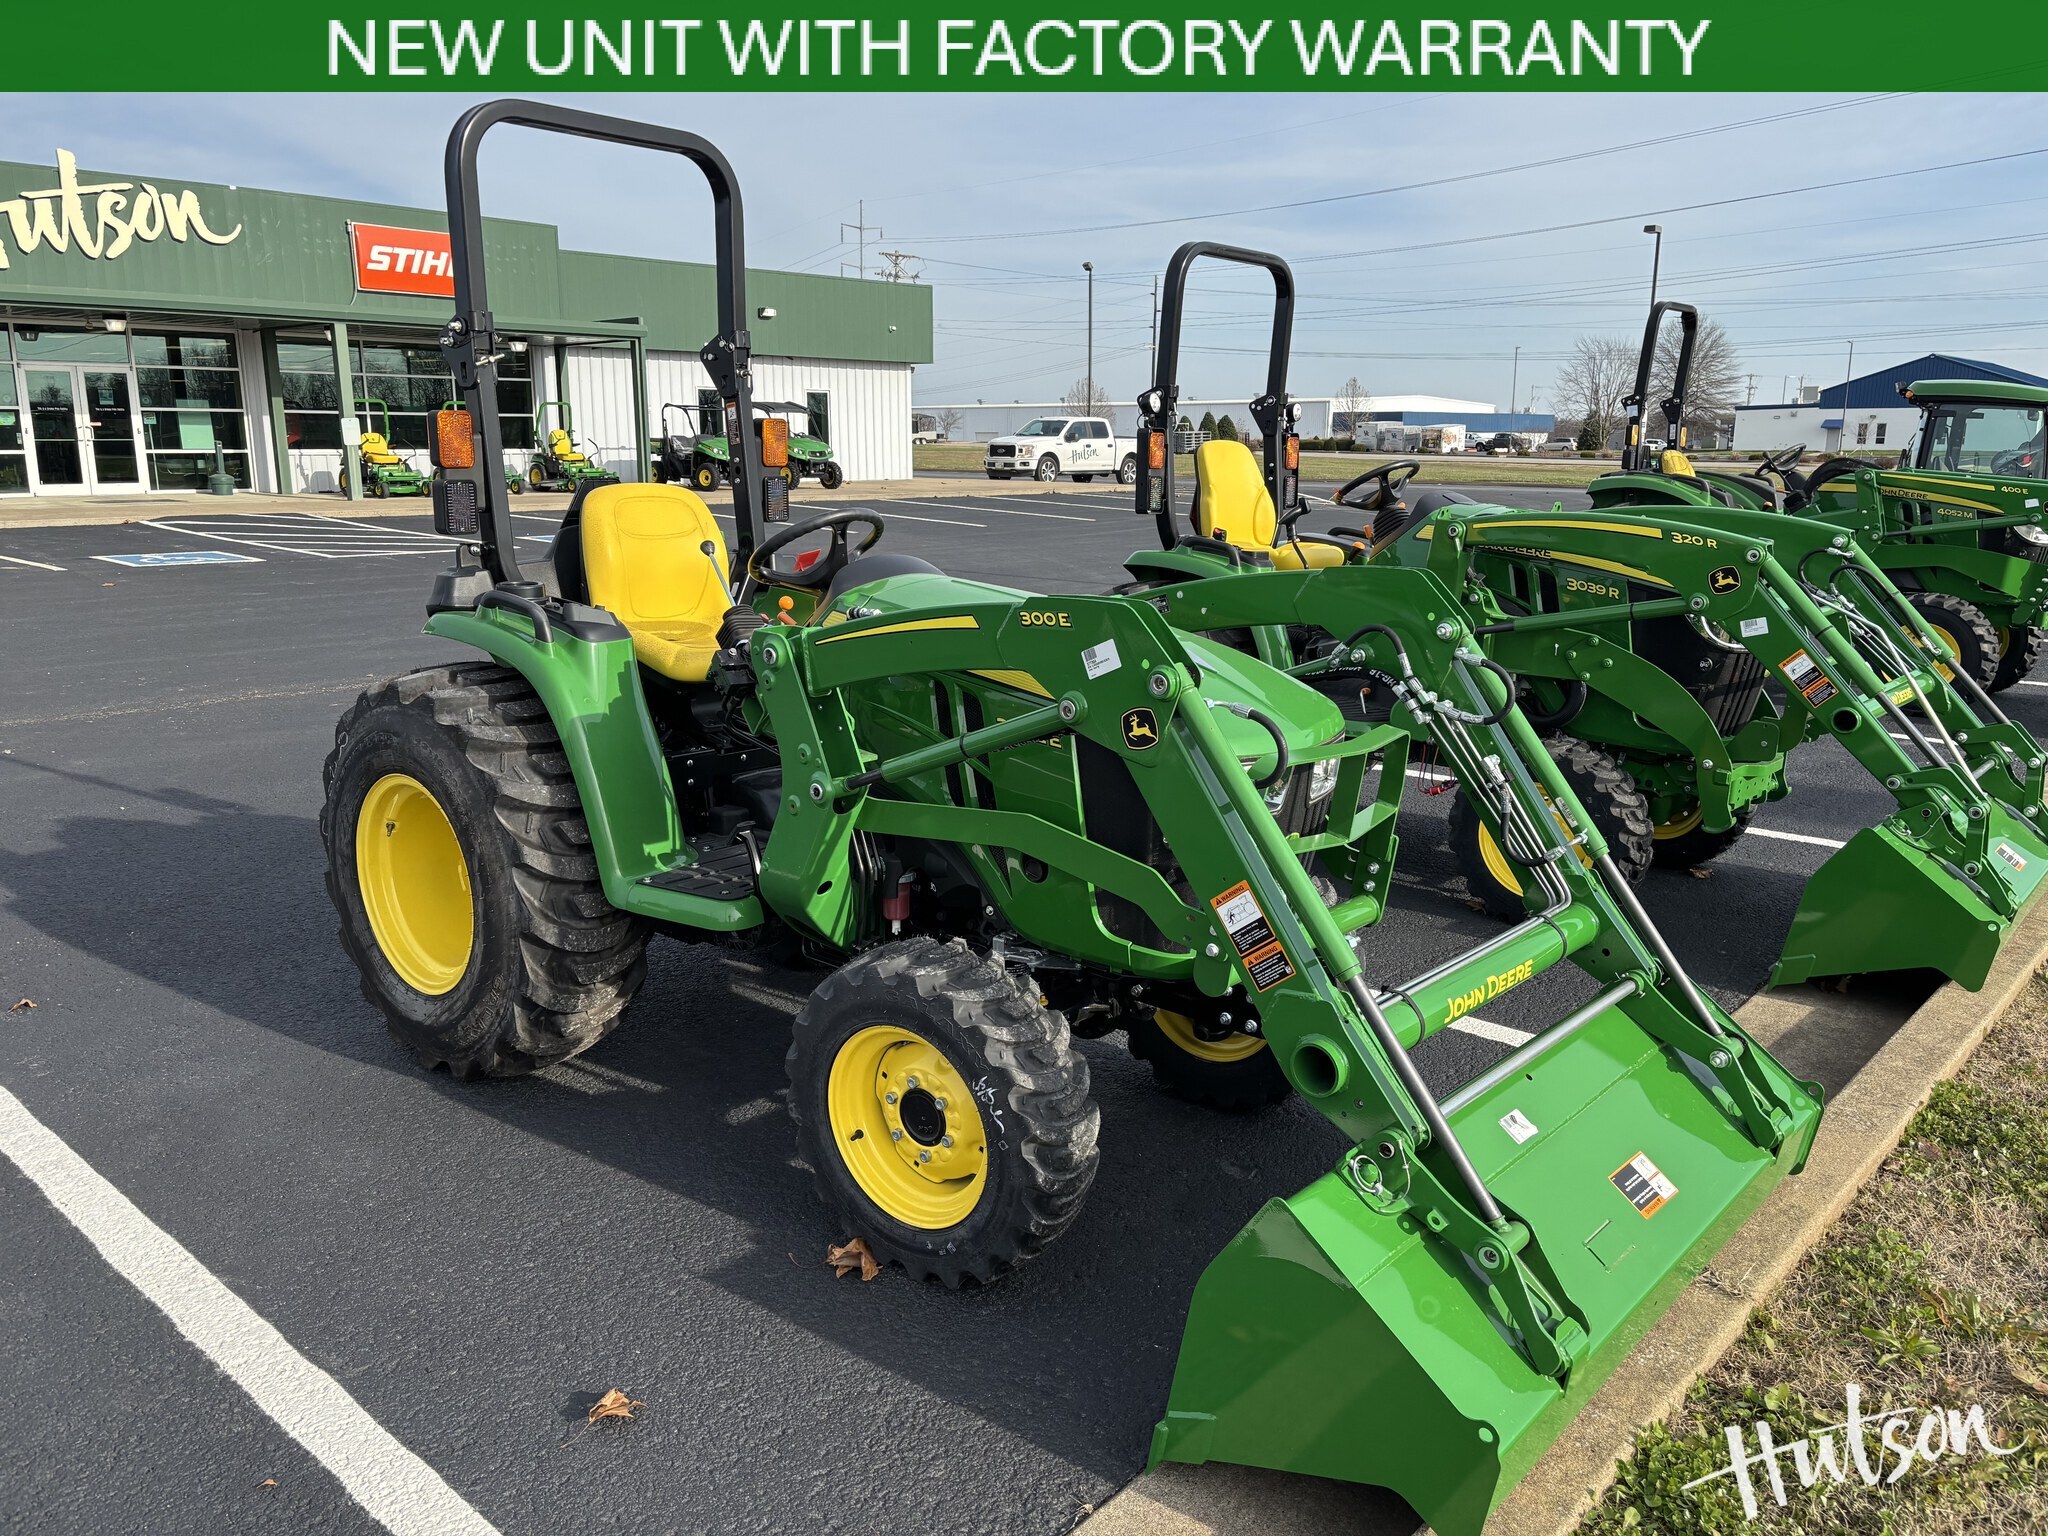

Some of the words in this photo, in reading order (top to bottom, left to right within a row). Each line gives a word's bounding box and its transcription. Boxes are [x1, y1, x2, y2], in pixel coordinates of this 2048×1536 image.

[0, 148, 242, 269] utson
[1067, 444, 1100, 464] Hutson
[1897, 489, 1929, 500] DEERE
[2000, 485, 2022, 495] 400
[1936, 507, 1963, 517] 4052
[1670, 531, 1704, 547] 320
[1707, 537, 1718, 549] R
[1566, 577, 1606, 596] 3039
[1608, 587, 1620, 600] R
[1019, 611, 1057, 627] 300
[1058, 612, 1072, 628] E
[1221, 884, 1245, 902] WARNING
[1254, 945, 1278, 962] WARNING
[1443, 984, 1486, 1024] JOHN
[1486, 959, 1534, 999] DEERE
